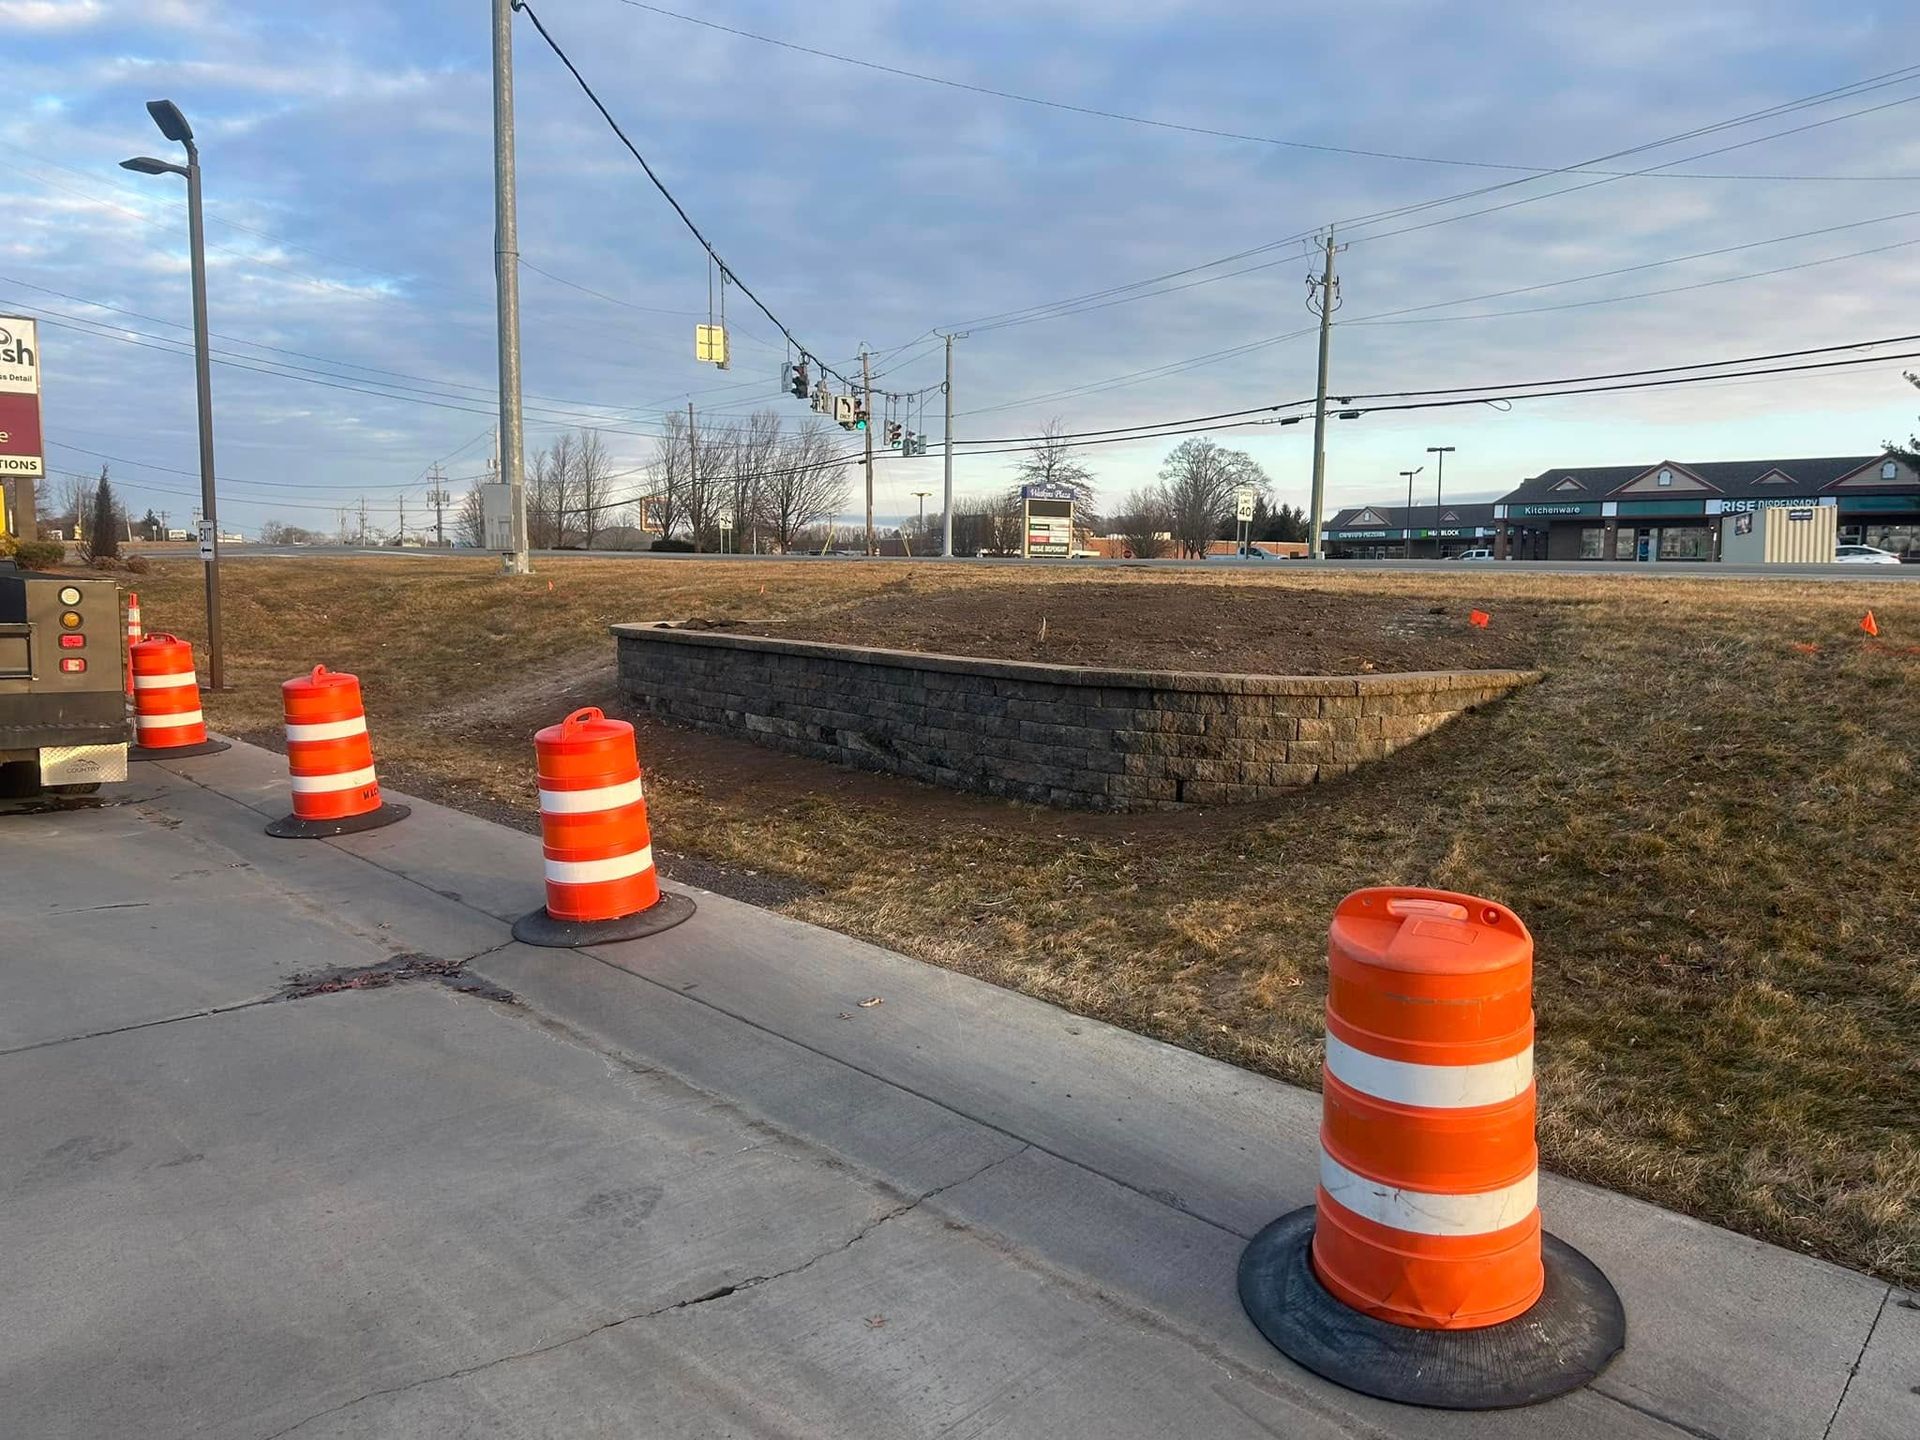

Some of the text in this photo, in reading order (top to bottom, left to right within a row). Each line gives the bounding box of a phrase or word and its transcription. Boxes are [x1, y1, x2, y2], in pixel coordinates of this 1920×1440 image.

[0, 338, 34, 366] sh
[9, 374, 32, 382] Detail
[1239, 506, 1251, 517] 40
[1524, 505, 1581, 515] Kitchenware
[1722, 500, 1756, 512] RISE
[363, 788, 379, 800] MAC
